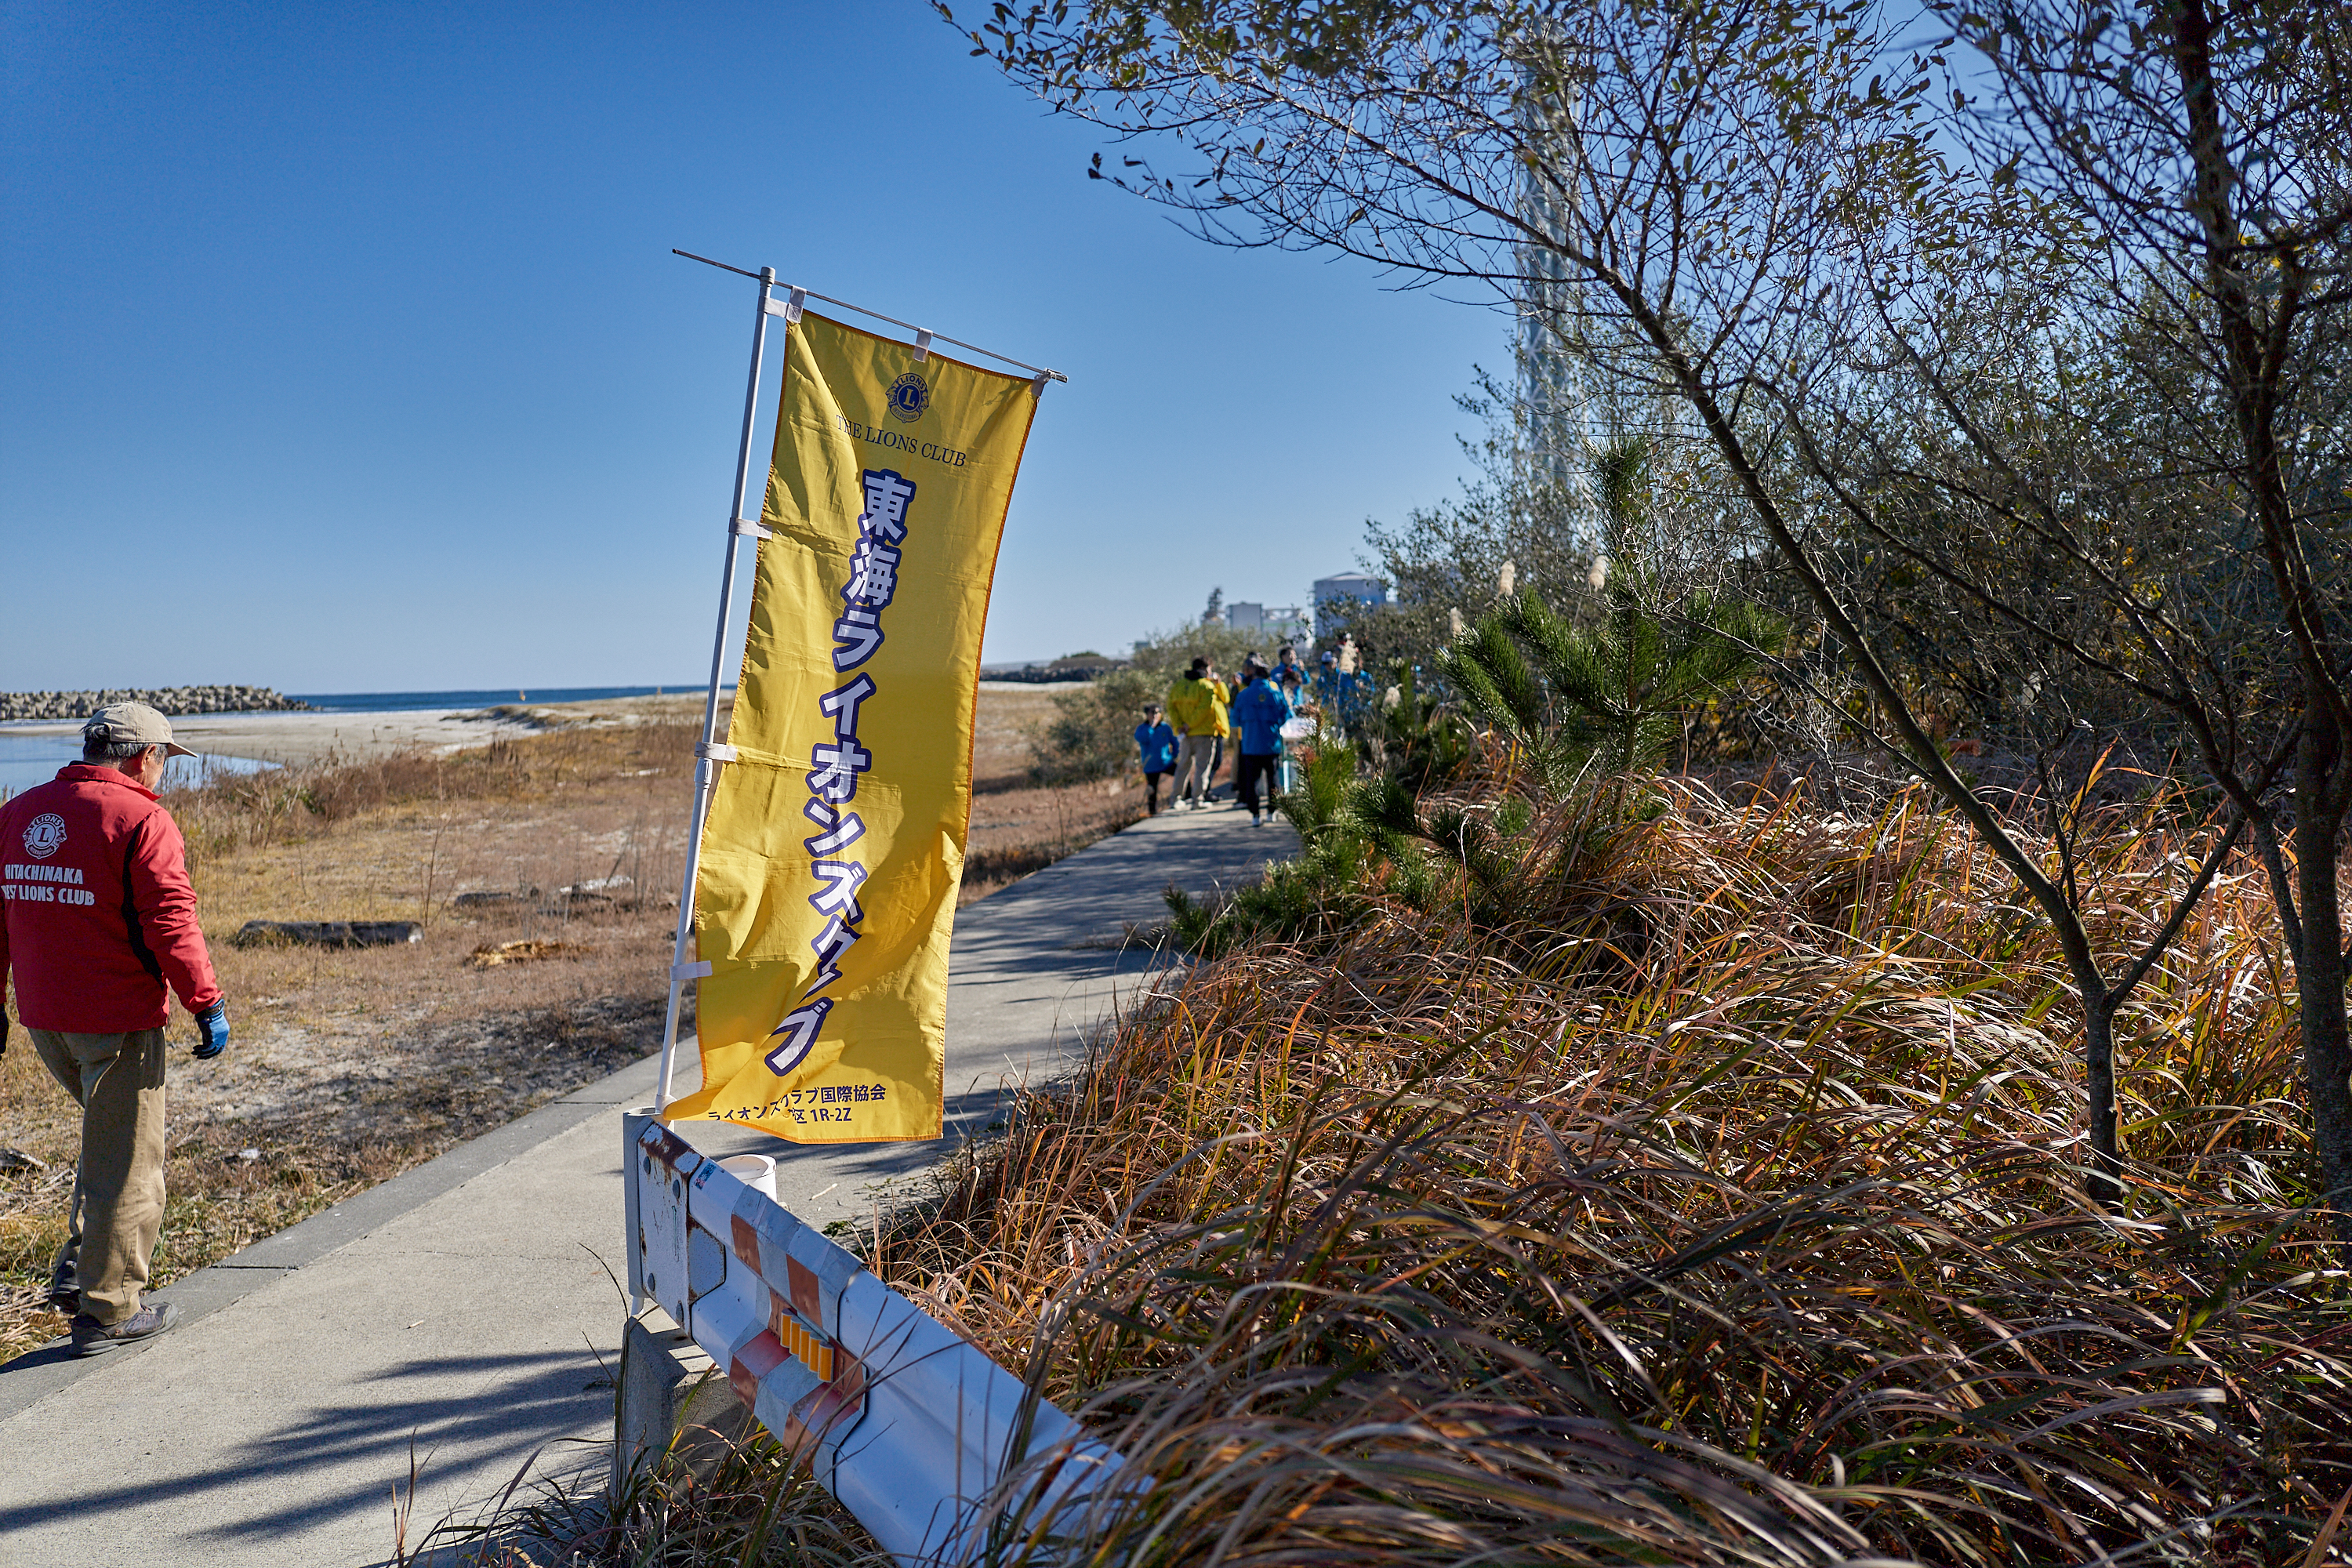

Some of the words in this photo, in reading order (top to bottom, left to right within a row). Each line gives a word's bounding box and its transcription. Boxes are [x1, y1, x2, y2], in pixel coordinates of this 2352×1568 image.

[899, 375, 925, 390] LIONS
[903, 388, 915, 408] L
[837, 415, 862, 439] THE
[864, 426, 918, 454] LIONS
[921, 442, 967, 466] CLUB
[35, 815, 62, 826] LIONS
[38, 827, 49, 843] L
[5, 864, 83, 885] HITACHINAKA
[19, 884, 55, 902] LIONS
[58, 887, 95, 906] CLUB
[810, 1107, 852, 1122] 1R-2Z
